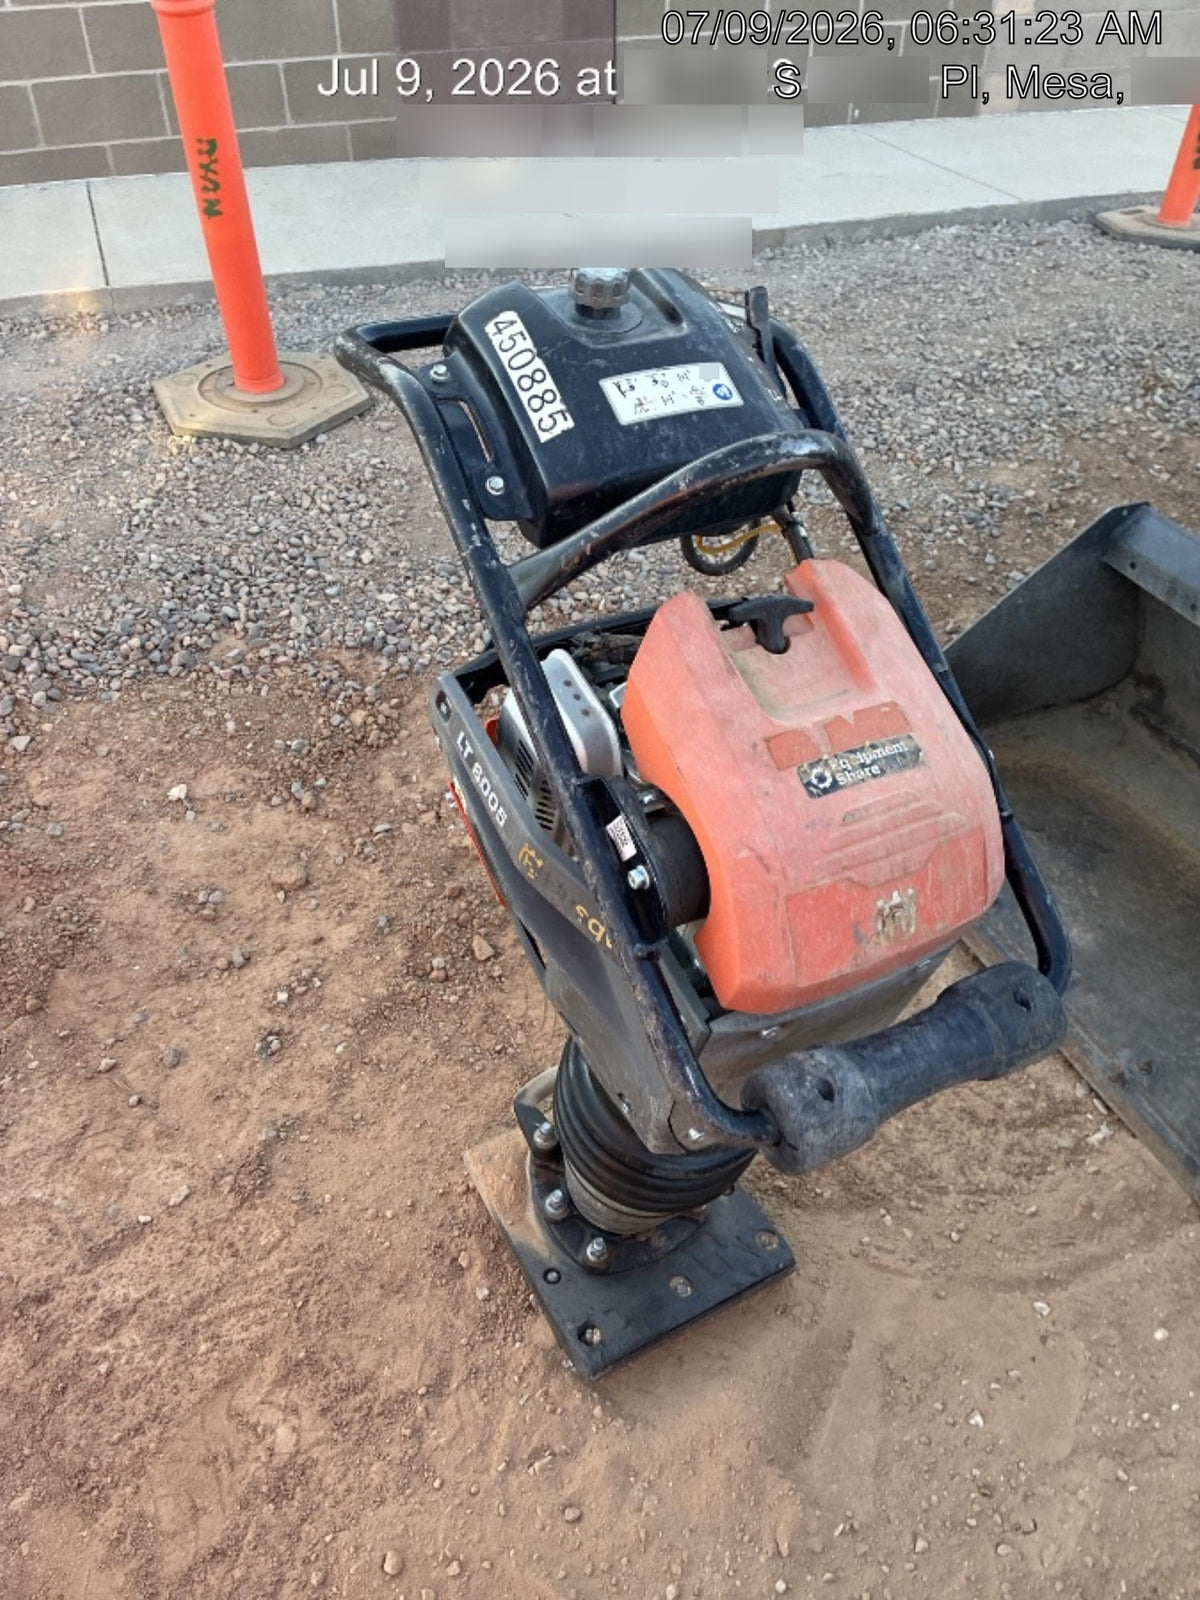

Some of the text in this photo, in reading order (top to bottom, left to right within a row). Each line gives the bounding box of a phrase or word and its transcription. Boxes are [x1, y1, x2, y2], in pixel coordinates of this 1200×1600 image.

[493, 317, 568, 434] 450885
[456, 730, 474, 759] LT
[835, 764, 881, 787] Share
